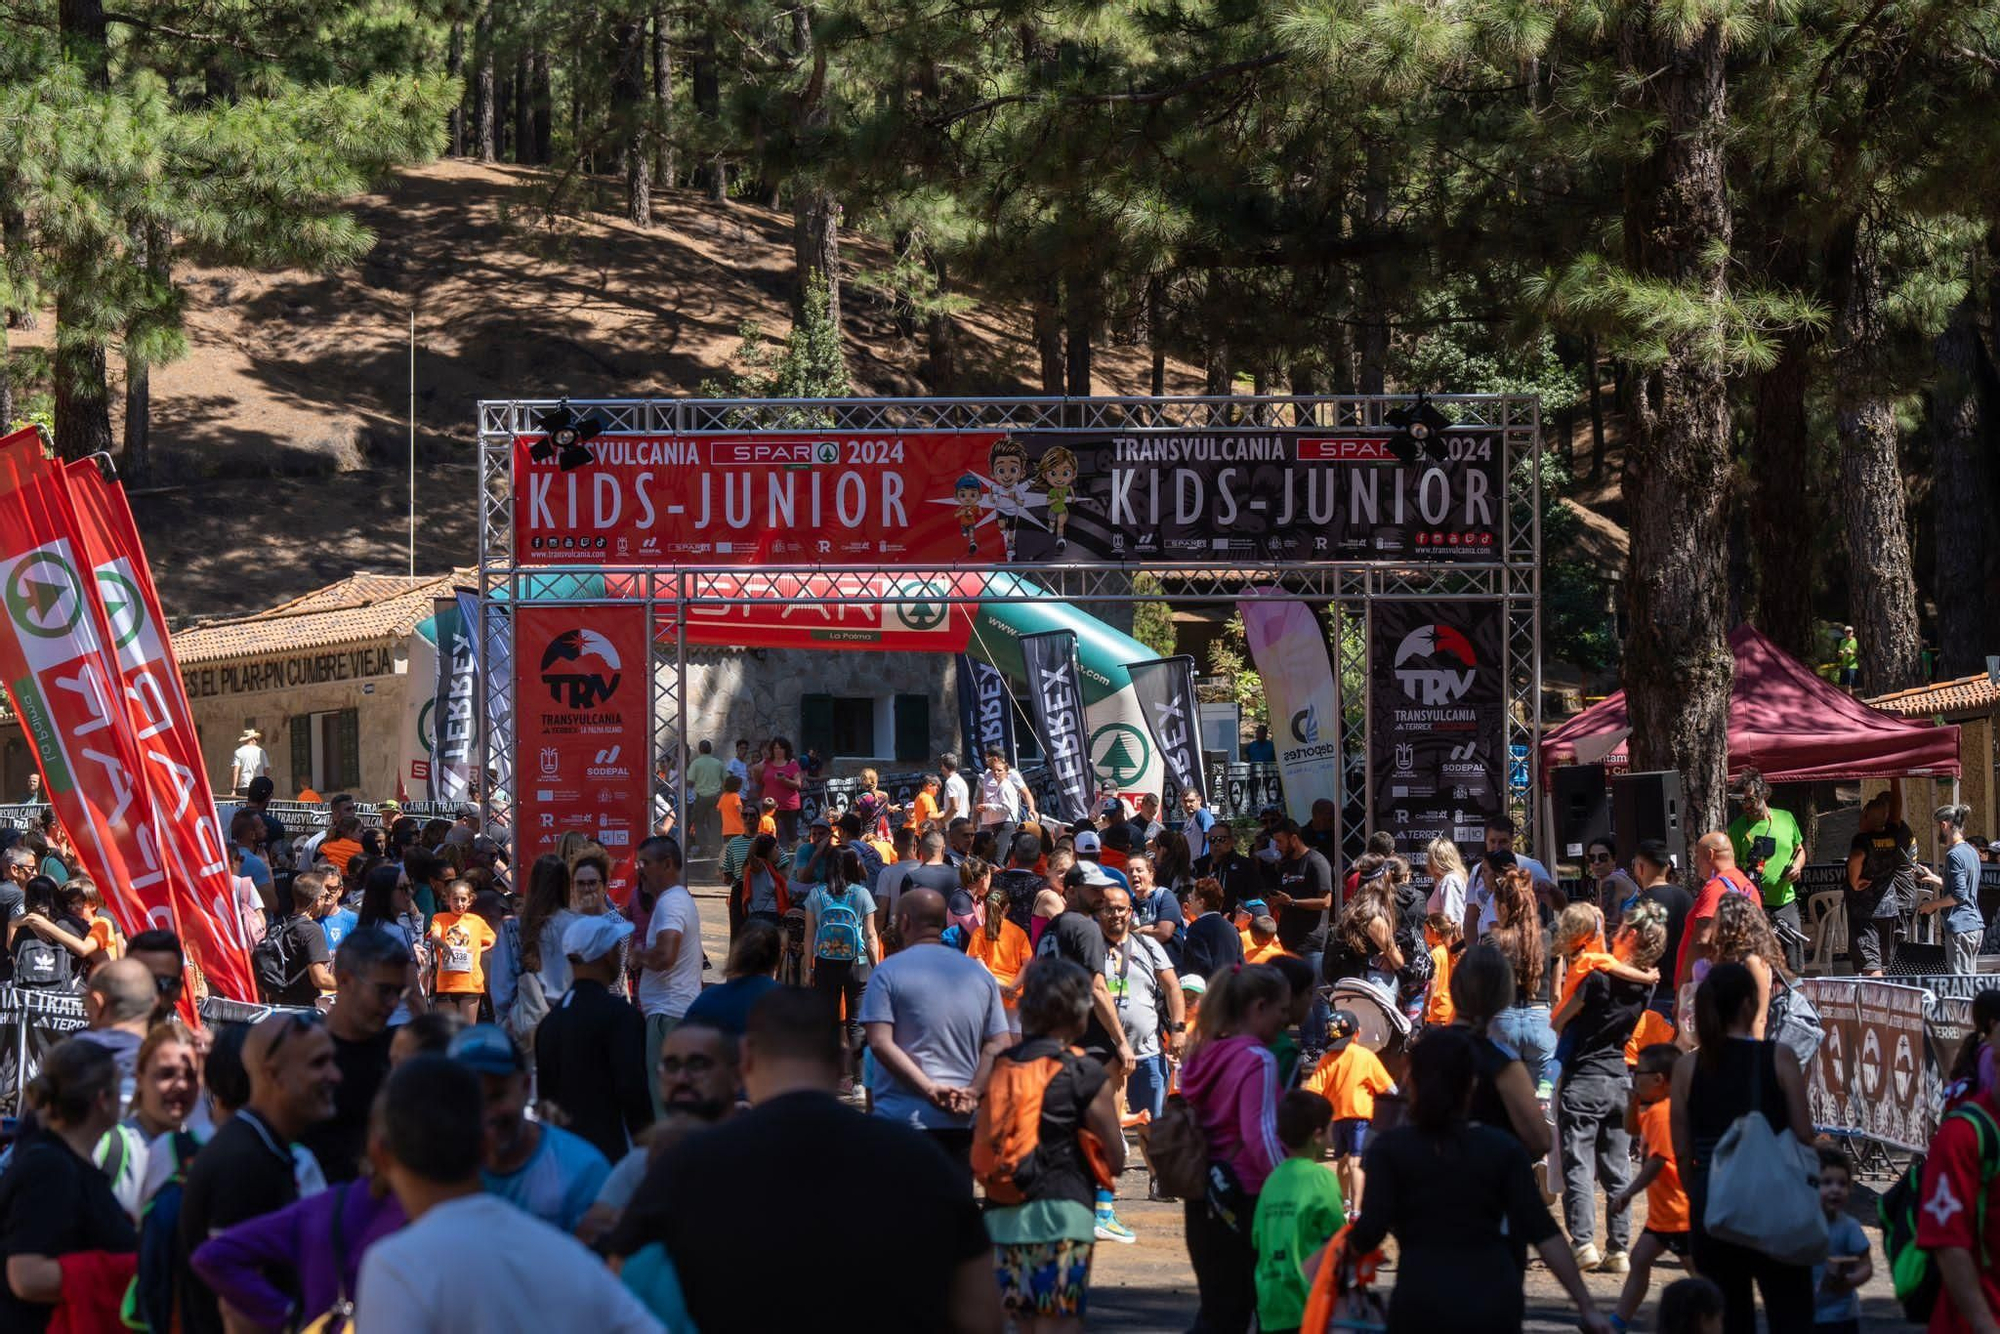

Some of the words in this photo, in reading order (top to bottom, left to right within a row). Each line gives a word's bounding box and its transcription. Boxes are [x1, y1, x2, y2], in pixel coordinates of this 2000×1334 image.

[733, 446, 810, 460] SPAR
[847, 441, 904, 464] 2024
[1113, 437, 1285, 460] TRANSVULCANIA
[1440, 437, 1491, 461] 024
[531, 471, 908, 529] KIDS-JUNIOR
[1111, 468, 1492, 525] KIDS-JUNIOR
[829, 632, 841, 640] La
[843, 633, 872, 641] Palma
[202, 670, 218, 697] EL
[287, 653, 347, 686] CUMBRE
[349, 647, 392, 678] VIEJA
[541, 714, 622, 725] TRANSVULCANIA
[1394, 710, 1476, 721] TRANSVULCANIA
[587, 767, 630, 775] SODEPAL
[1442, 763, 1485, 772] SODEPAL
[1408, 830, 1444, 839] TERREX
